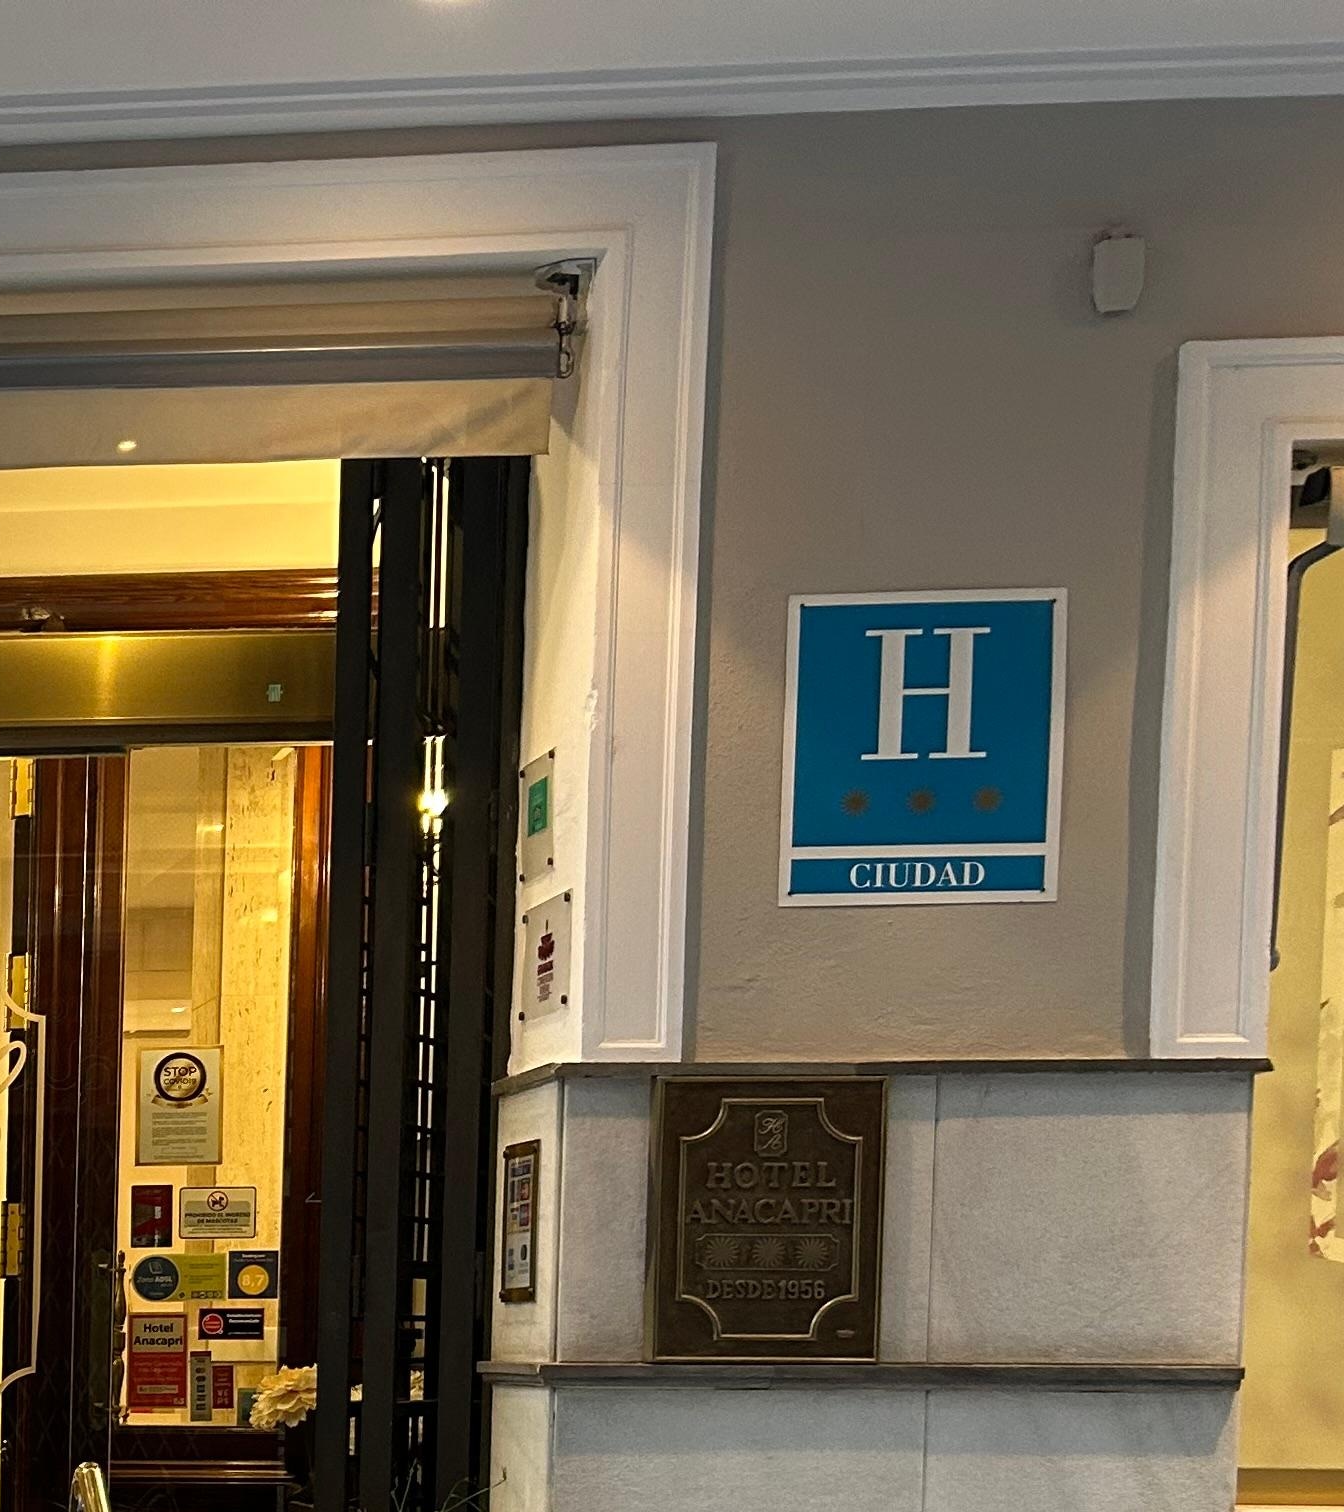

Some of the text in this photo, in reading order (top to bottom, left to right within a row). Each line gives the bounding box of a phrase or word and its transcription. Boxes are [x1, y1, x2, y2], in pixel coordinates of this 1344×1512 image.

[861, 626, 992, 761] H
[849, 860, 986, 889] CIUDAD
[163, 1066, 197, 1077] STOP
[706, 1160, 838, 1190] HOTEL
[685, 1198, 854, 1226] ANACAPRI
[241, 1273, 265, 1287] 8,7
[143, 1323, 174, 1333] Hotel
[133, 1335, 183, 1348] Anacapri
